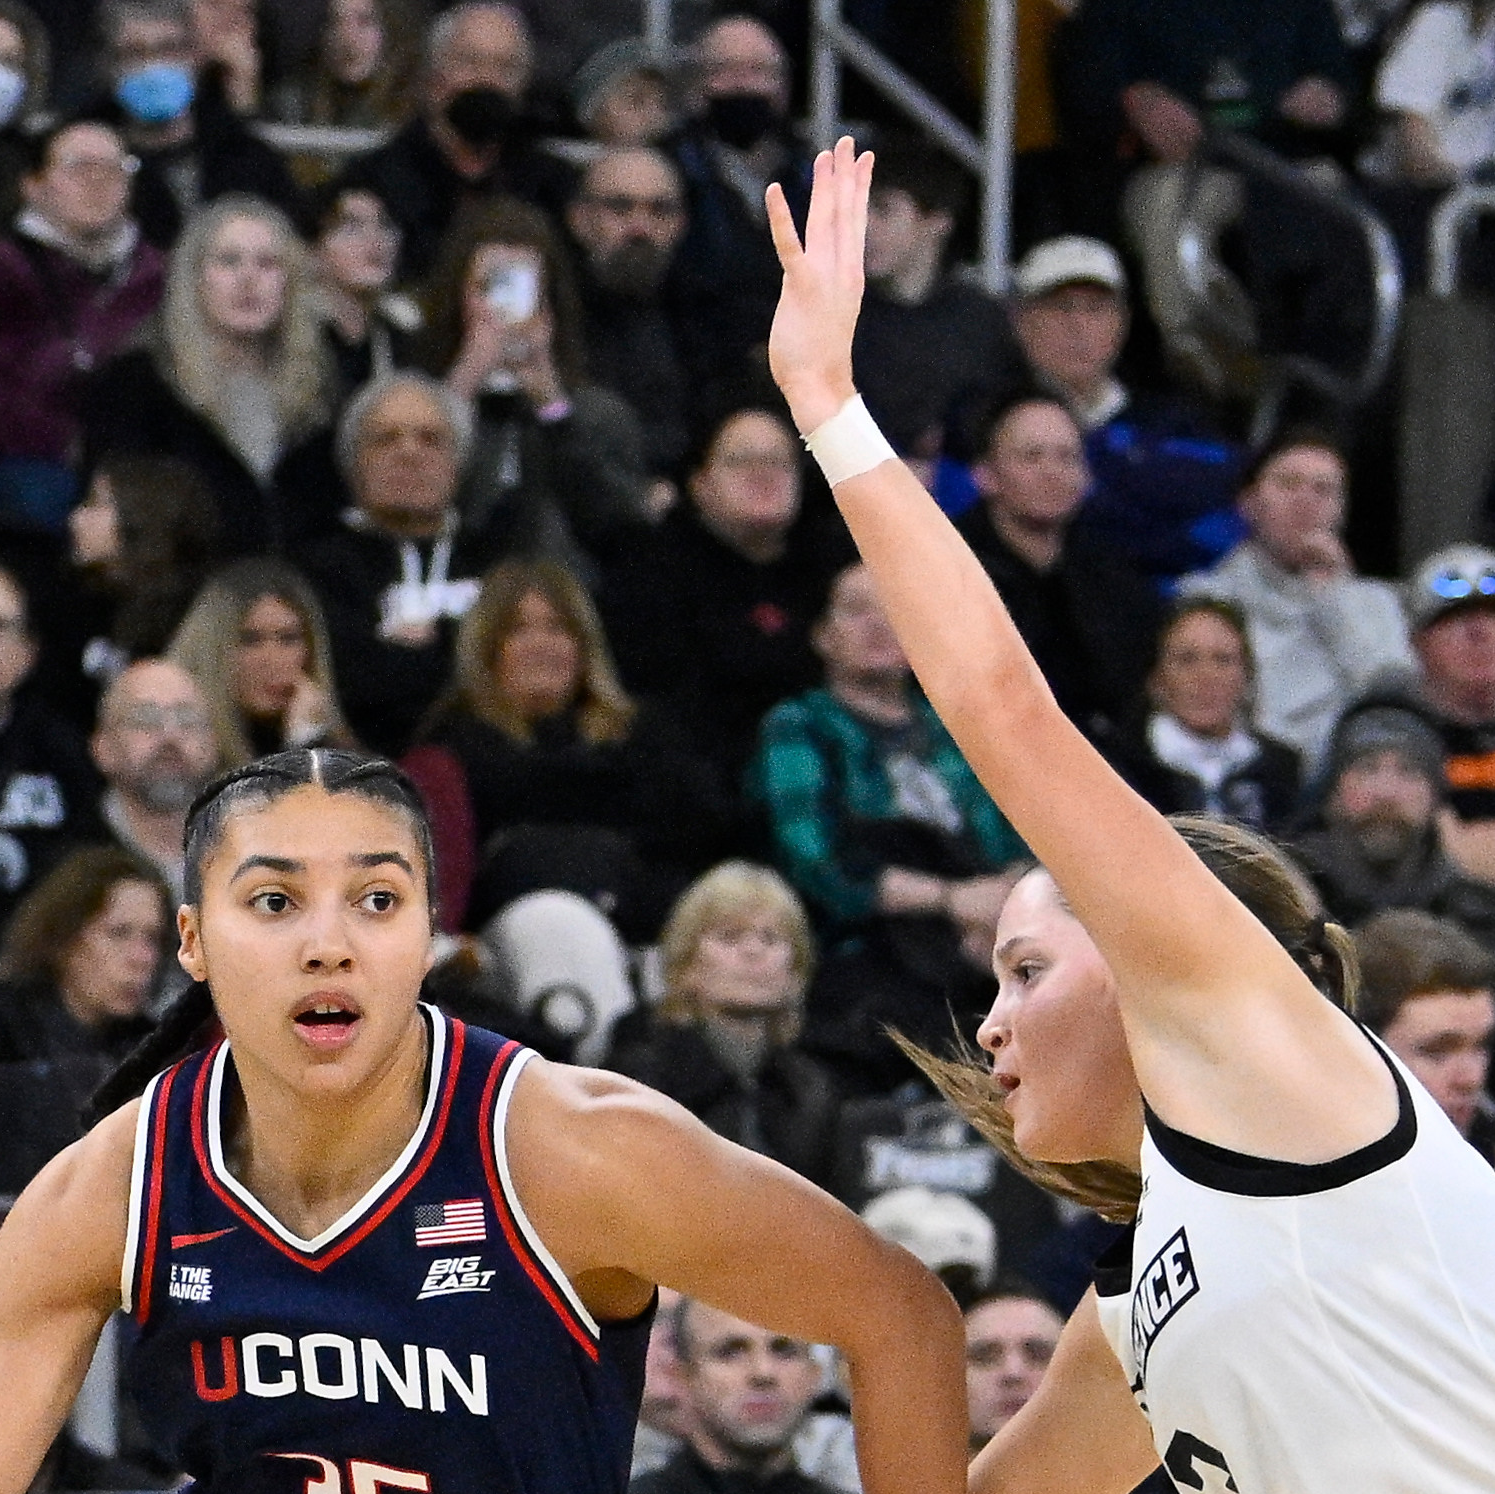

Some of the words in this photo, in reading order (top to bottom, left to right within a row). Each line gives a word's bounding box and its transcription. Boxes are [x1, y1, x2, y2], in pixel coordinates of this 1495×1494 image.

[180, 1266, 212, 1284] THE
[428, 1255, 482, 1275] BIG
[421, 1270, 497, 1292] EAST
[191, 1332, 489, 1416] UCONN
